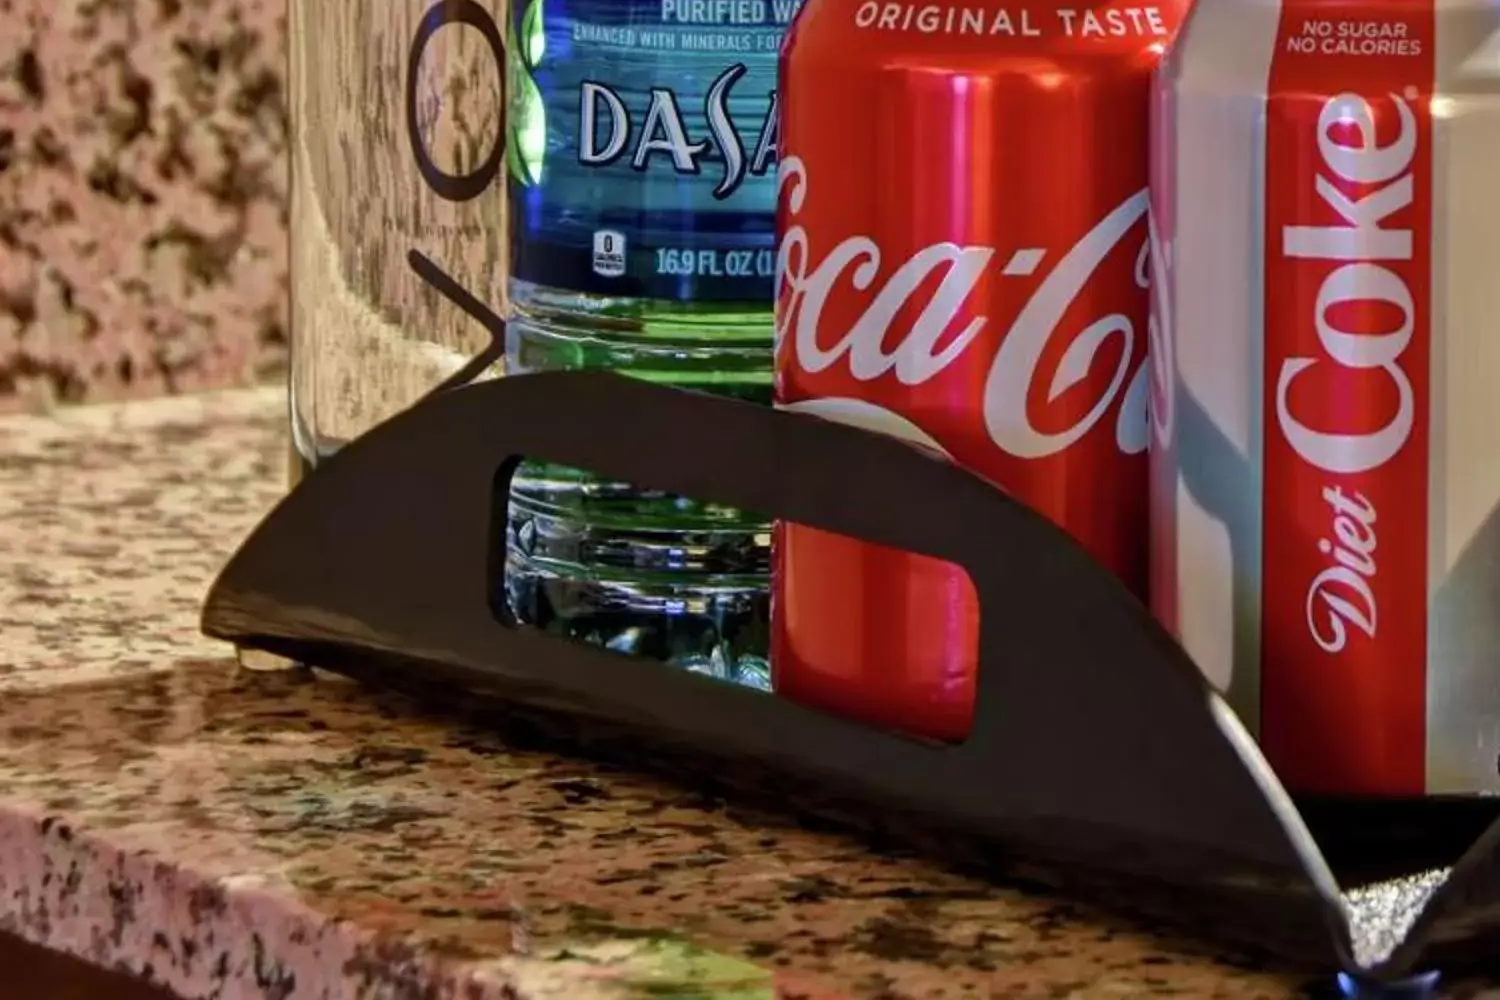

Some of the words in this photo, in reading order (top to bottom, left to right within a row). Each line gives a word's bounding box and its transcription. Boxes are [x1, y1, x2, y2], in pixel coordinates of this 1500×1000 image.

[854, 0, 1041, 37] ORIGINAL
[1056, 6, 1168, 37] TASTE
[1302, 19, 1333, 37] NO
[1338, 20, 1408, 39] SUGAR
[573, 22, 636, 46] ENHANCED
[639, 31, 676, 50] WITH
[680, 33, 751, 50] MINERALS
[1286, 36, 1317, 54] NO
[1321, 37, 1423, 56] CALORIES
[603, 234, 613, 254] 0
[656, 247, 696, 275] 16.9
[698, 249, 723, 276] FL
[725, 249, 755, 276] OZ
[1276, 91, 1419, 474] Coke
[1306, 483, 1378, 654] Diet
